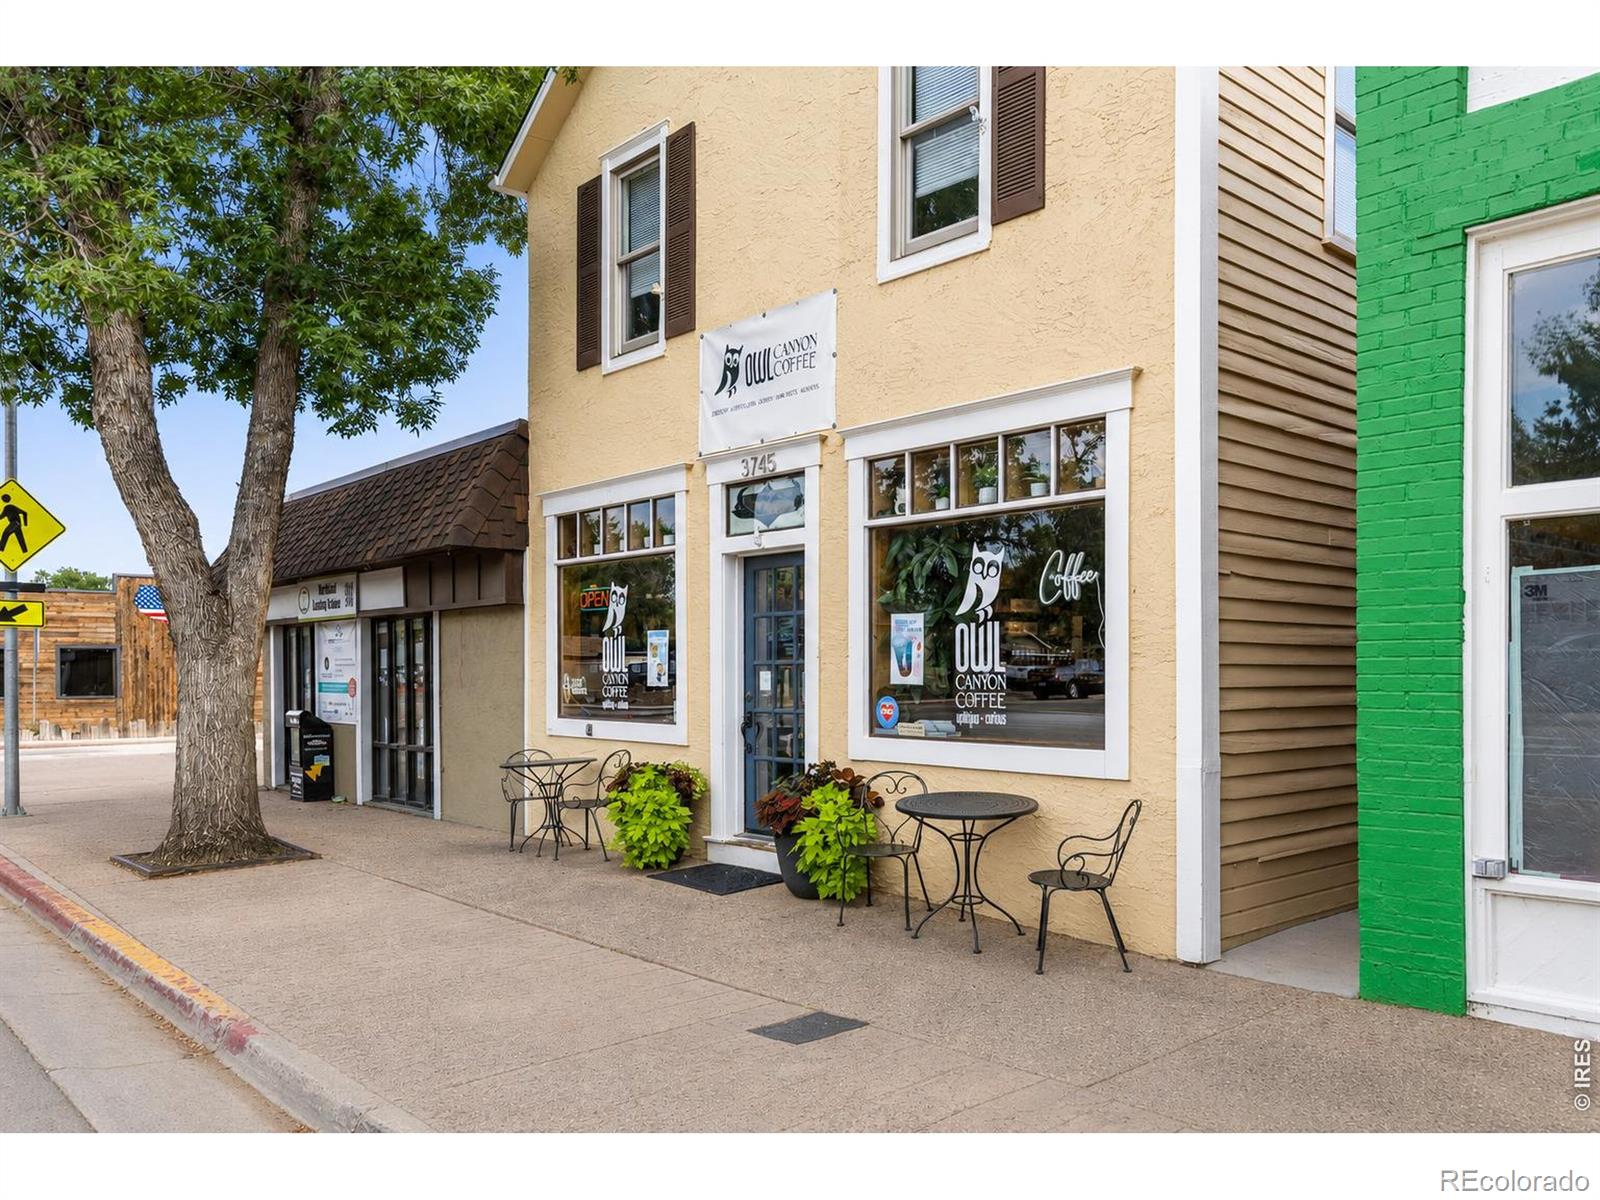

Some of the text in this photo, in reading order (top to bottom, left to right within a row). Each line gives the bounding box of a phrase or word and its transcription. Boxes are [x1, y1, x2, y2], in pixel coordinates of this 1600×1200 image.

[745, 332, 818, 387] OWL CANYON
[773, 351, 816, 377] COFFEE
[741, 452, 777, 478] 3745
[1039, 549, 1098, 605] Coffee
[579, 590, 609, 609] OPEN
[1524, 584, 1548, 597] 3M
[602, 635, 628, 672] OWL
[955, 621, 1007, 673] OWL
[602, 686, 628, 698] COFFEE
[955, 673, 1007, 690] CANYON
[955, 692, 1007, 709] COFFEE
